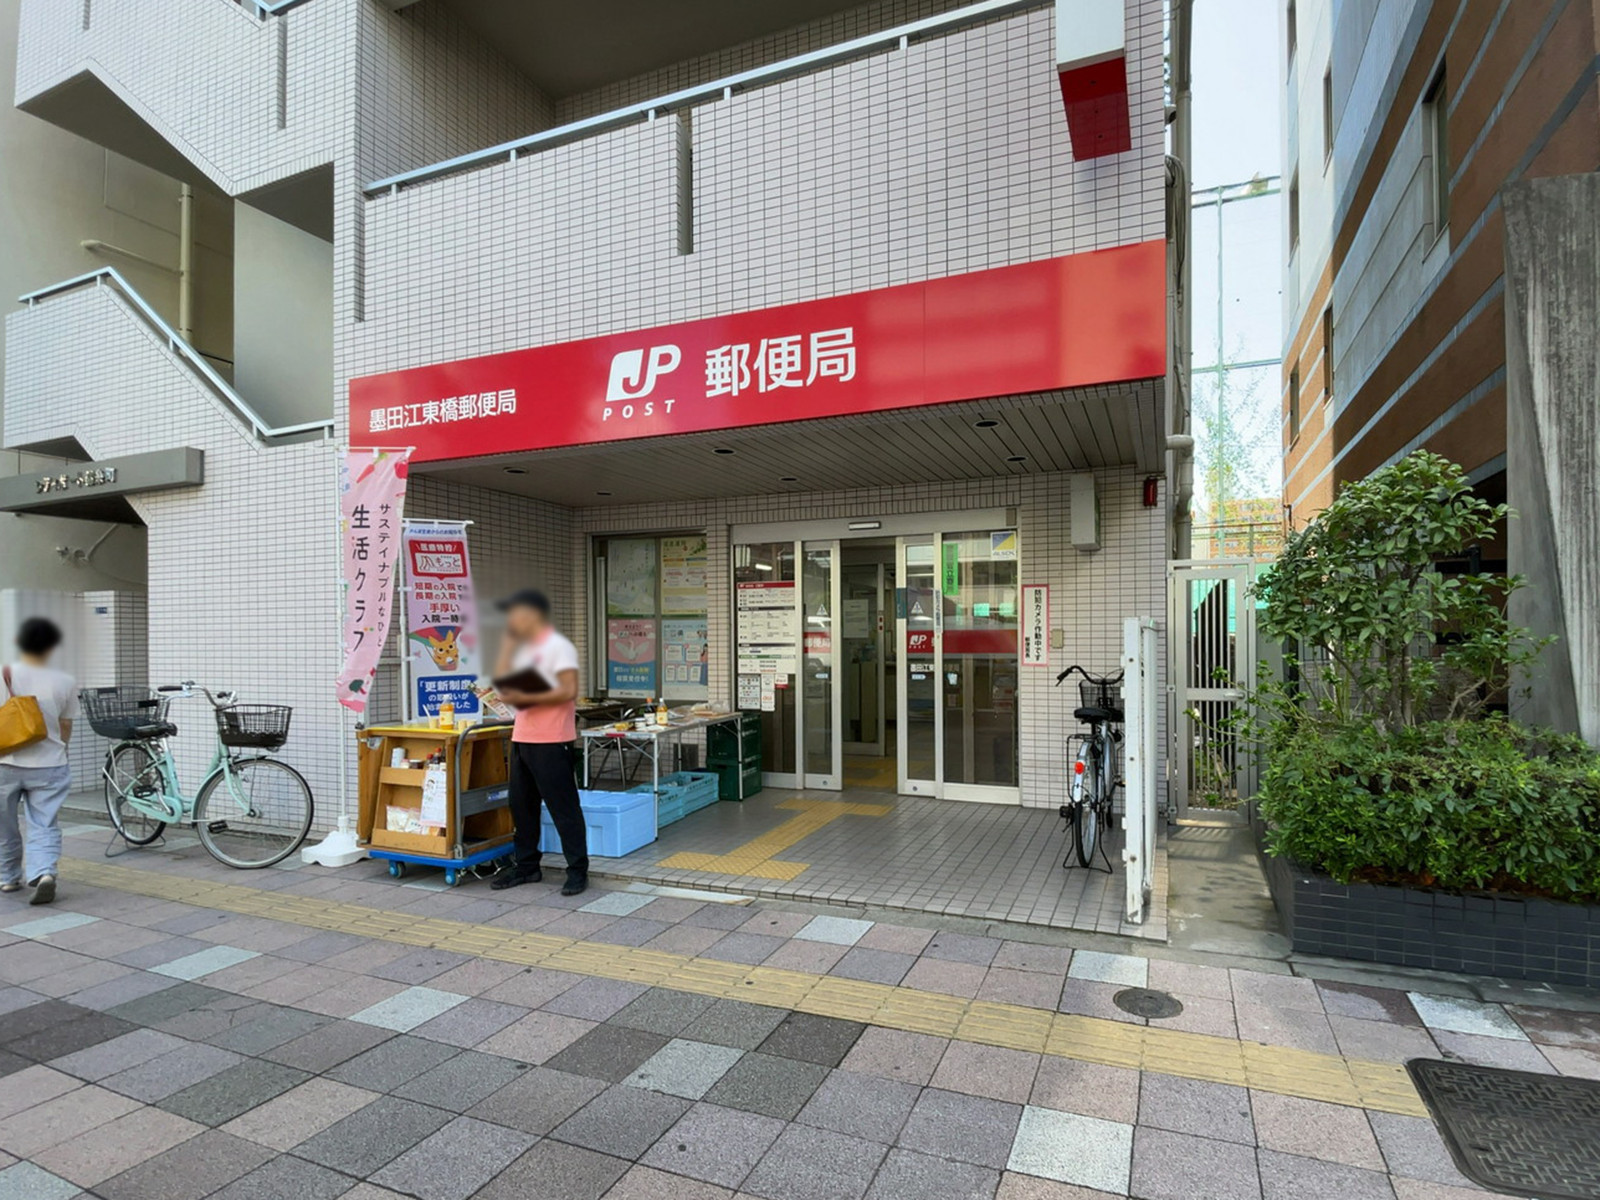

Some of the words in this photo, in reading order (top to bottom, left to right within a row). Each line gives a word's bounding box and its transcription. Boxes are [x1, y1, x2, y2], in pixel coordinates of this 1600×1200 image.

[606, 344, 681, 402] JP
[705, 326, 856, 398] 郵便局
[369, 389, 517, 433] 墨田江東橋郵便局
[602, 399, 675, 421] POST
[351, 503, 372, 652] 生活クラブ
[421, 614, 466, 623] 入院一時
[429, 603, 460, 613] 手厚い
[1034, 588, 1042, 662] 防犯カメラ作動中です
